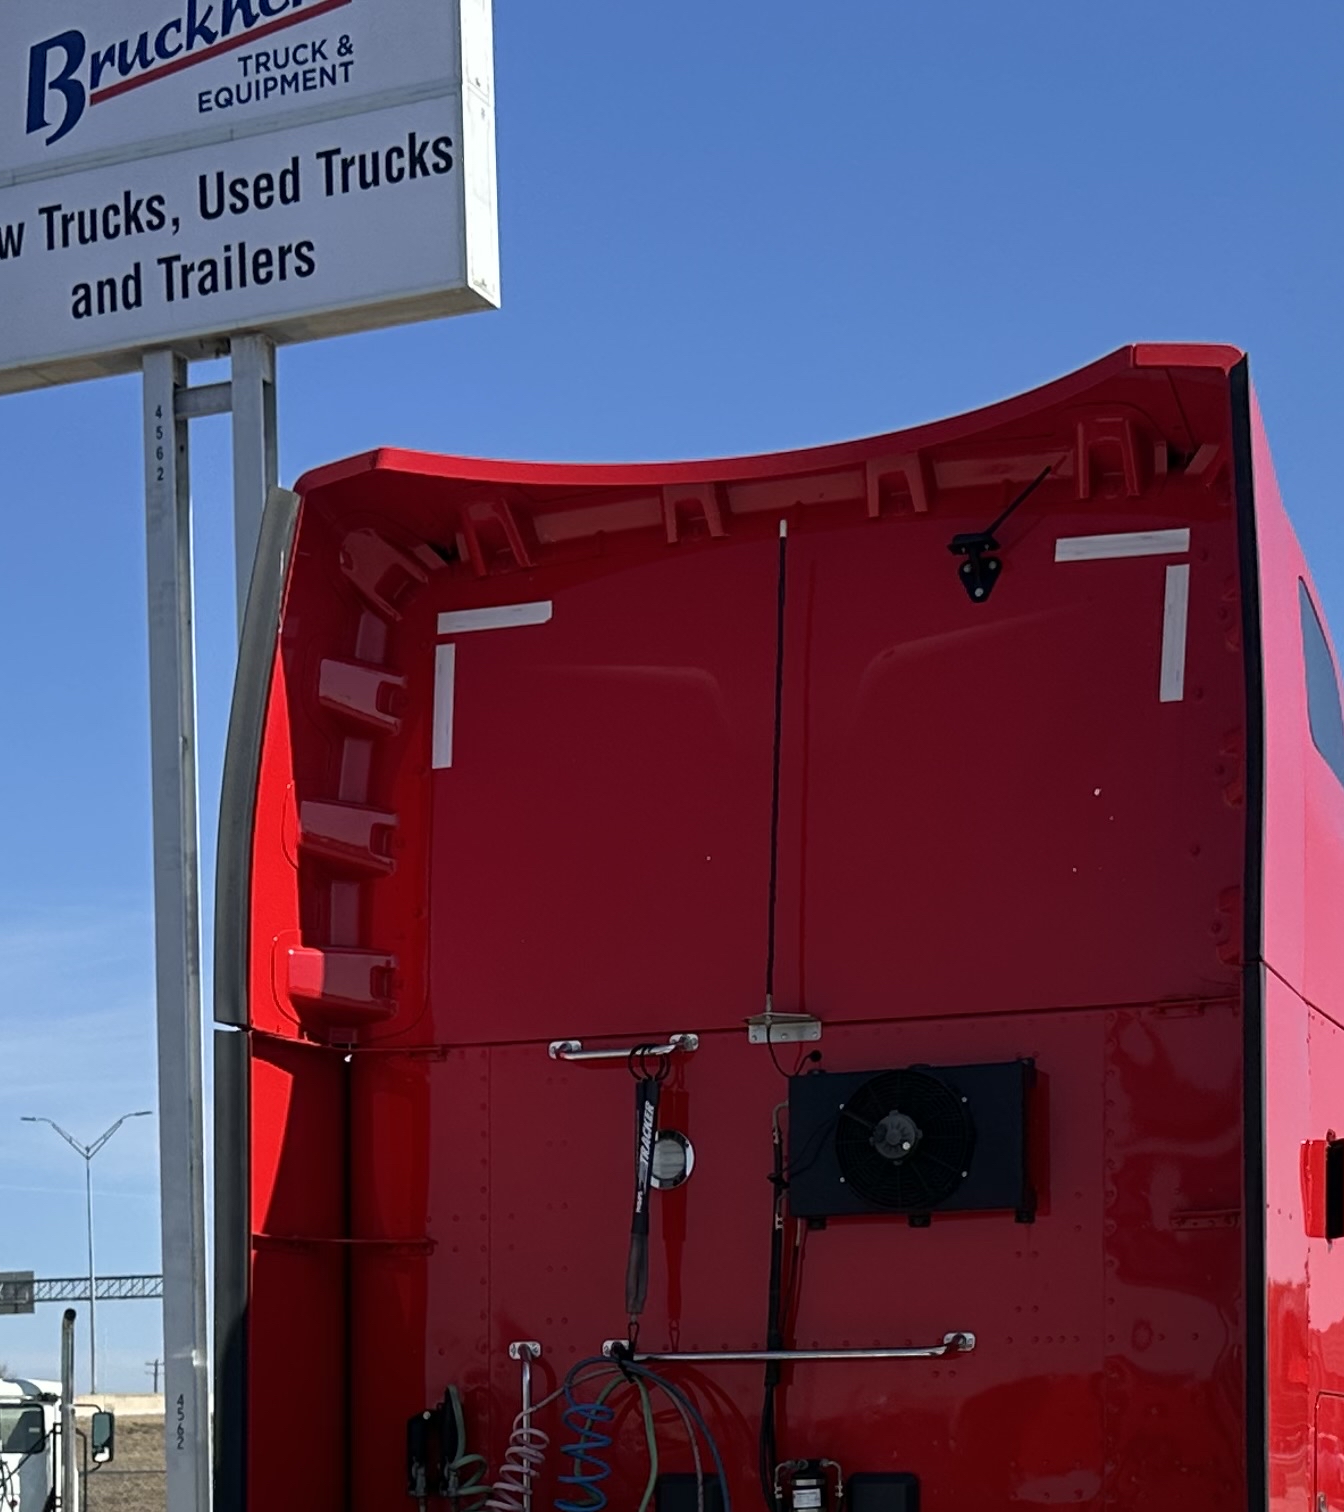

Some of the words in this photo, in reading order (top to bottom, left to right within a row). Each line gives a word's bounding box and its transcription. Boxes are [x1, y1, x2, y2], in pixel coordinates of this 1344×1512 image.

[26, 0, 304, 146] Bruckn
[198, 61, 354, 113] EQUIPMENT
[238, 39, 327, 77] TRUCK
[337, 34, 354, 57] &
[38, 190, 181, 252] Trucks,
[198, 156, 301, 221] Used
[317, 132, 453, 197] Trucks
[71, 269, 142, 319] and
[157, 240, 316, 305] Trailers
[155, 404, 164, 482] 4562
[639, 1100, 655, 1164] TRACKER
[176, 1394, 185, 1450] 4562
